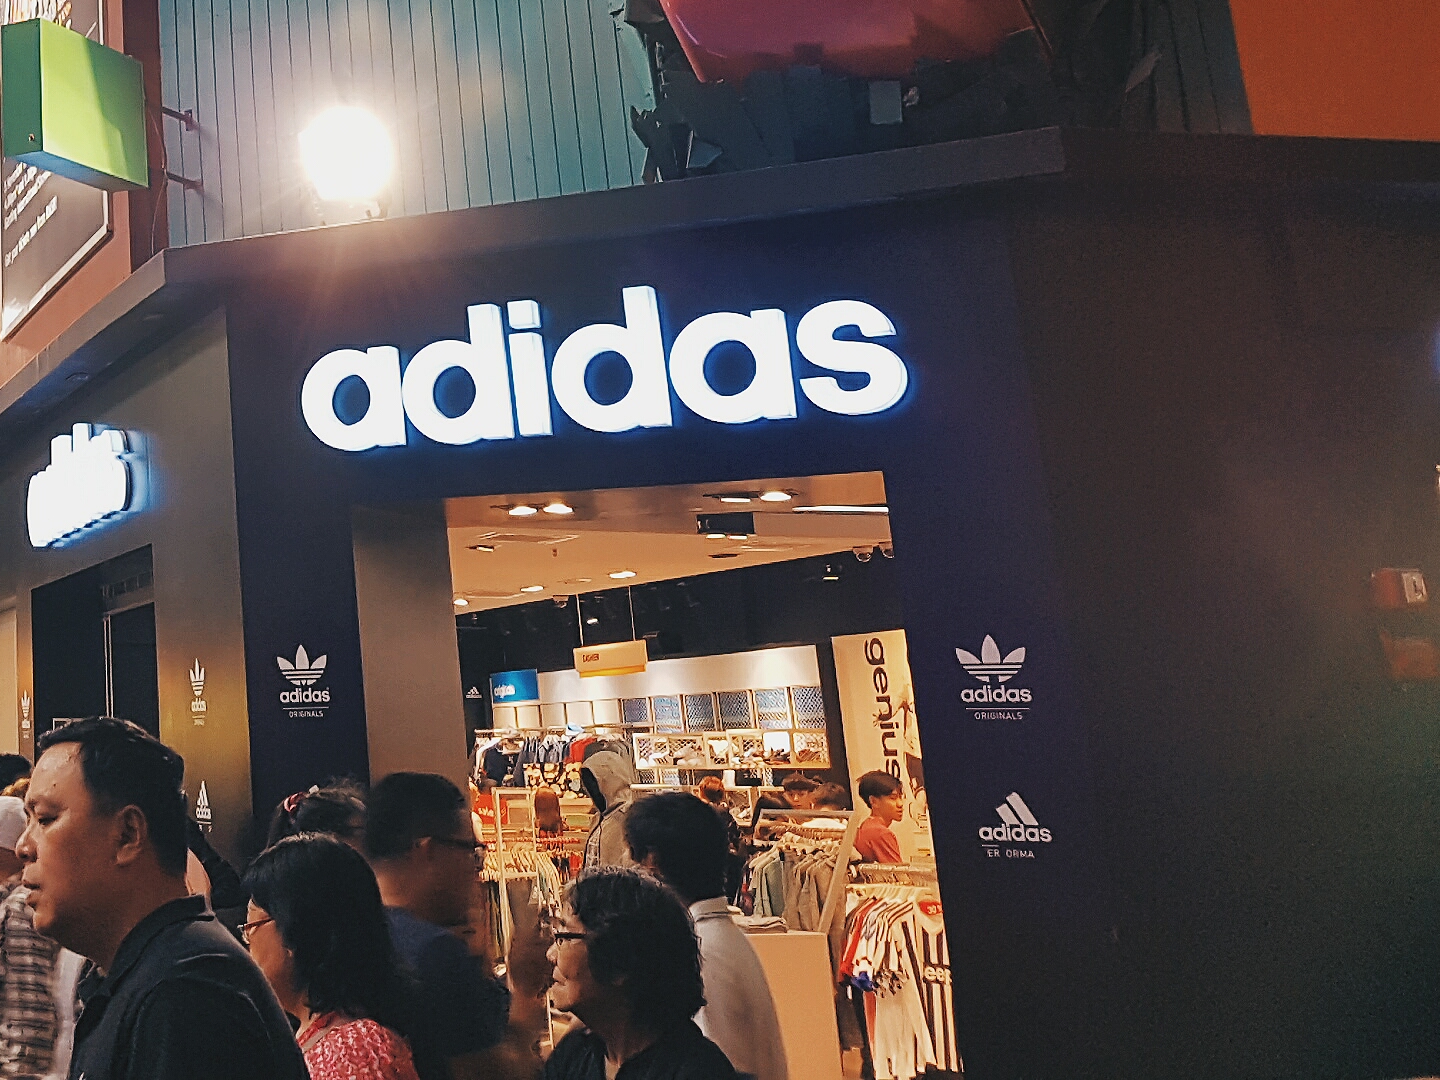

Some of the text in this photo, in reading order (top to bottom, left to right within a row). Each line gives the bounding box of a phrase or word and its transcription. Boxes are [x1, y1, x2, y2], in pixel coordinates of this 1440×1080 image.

[302, 285, 908, 451] adidas
[279, 687, 331, 703] adidas
[960, 684, 1033, 704] adidas
[973, 711, 1024, 720] ORIGINALS
[978, 823, 1053, 843] adidas
